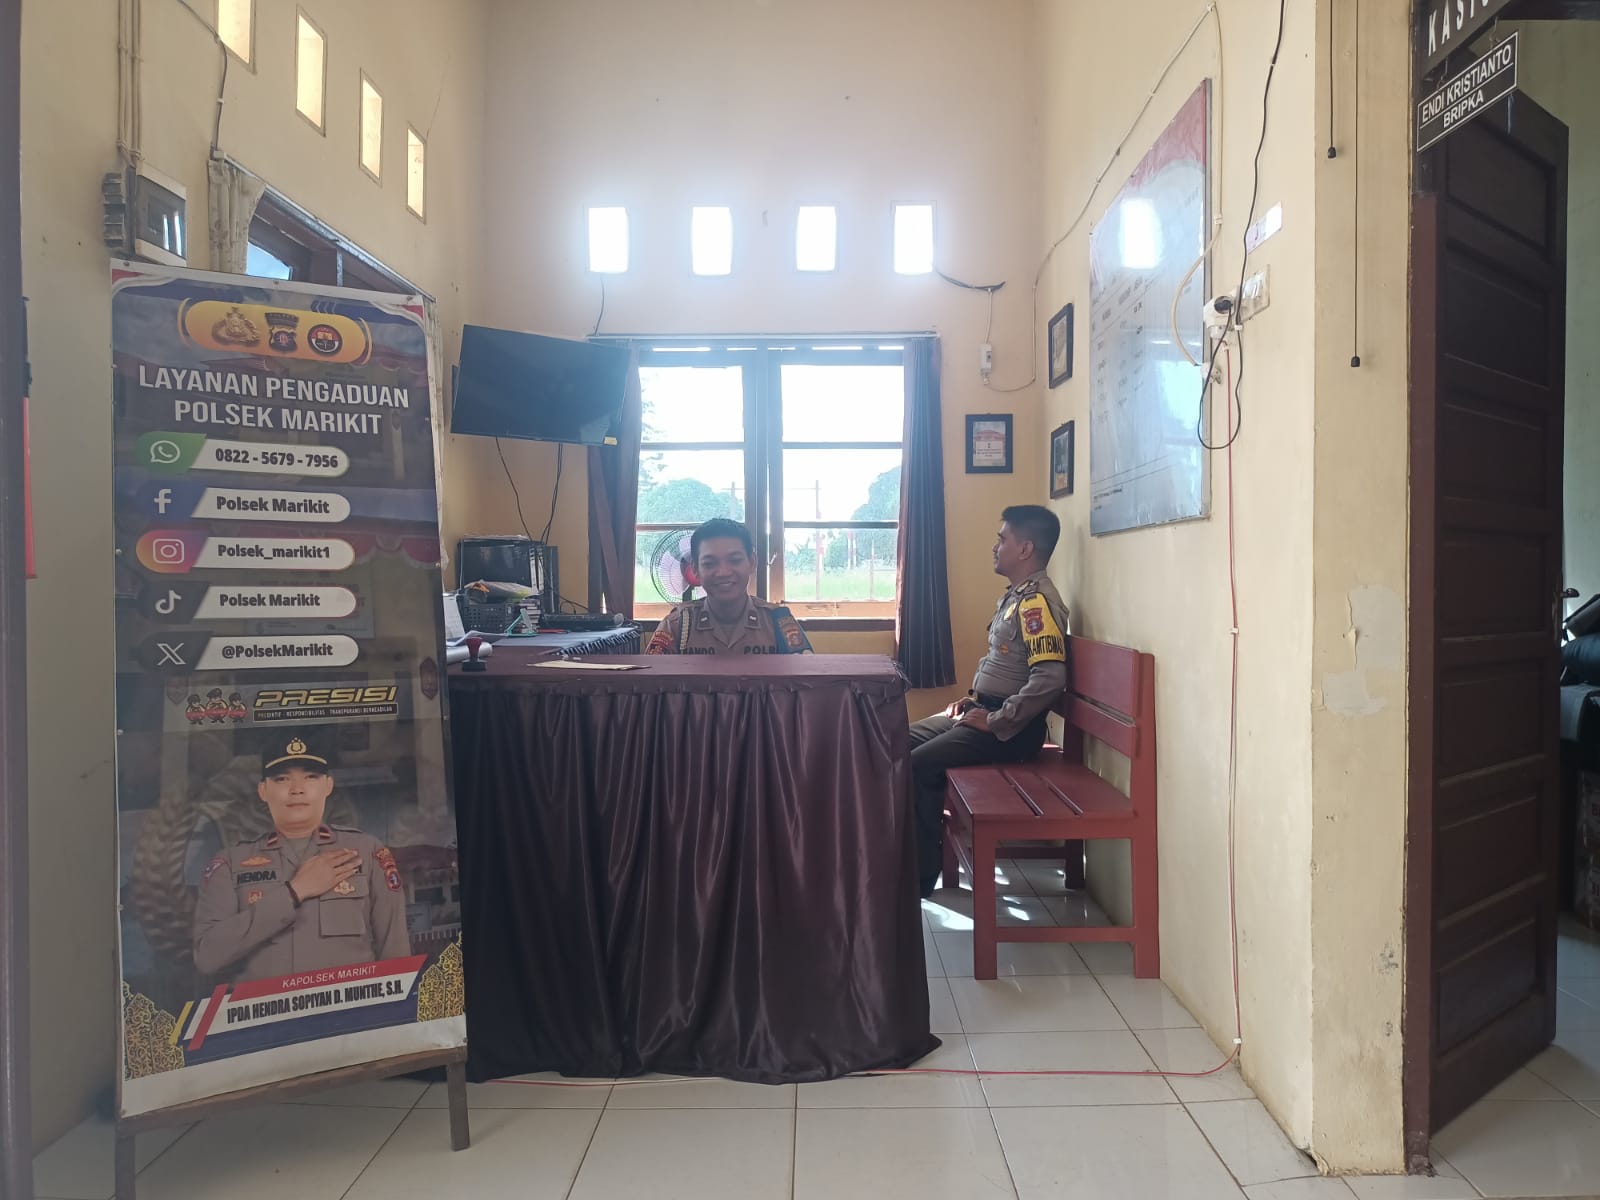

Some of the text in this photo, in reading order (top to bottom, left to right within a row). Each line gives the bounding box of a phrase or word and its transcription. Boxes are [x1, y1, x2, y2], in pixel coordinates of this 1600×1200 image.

[1422, 44, 1511, 123] ENDI KRISTIANTO
[1443, 89, 1484, 128] BRIPKA
[139, 365, 409, 408] LAYANAN PENGADUAN
[174, 400, 382, 435] POLSEK MARIKIT
[215, 448, 250, 464] 0822
[261, 452, 295, 466] 5679
[305, 454, 339, 468] 7956
[216, 496, 330, 514] Polsek Marikit
[218, 544, 330, 560] Polsek_marikit1
[219, 593, 320, 607] Polsek Marikit
[221, 643, 334, 659] @PolsekMarikit
[255, 686, 398, 707] PRESISI
[237, 870, 277, 884] HENDRA
[282, 965, 377, 989] KAPOLSEK MARIKIT
[227, 979, 404, 1024] IPDA HENDRA SOPIYAN D. MUNTHE, S.H.
